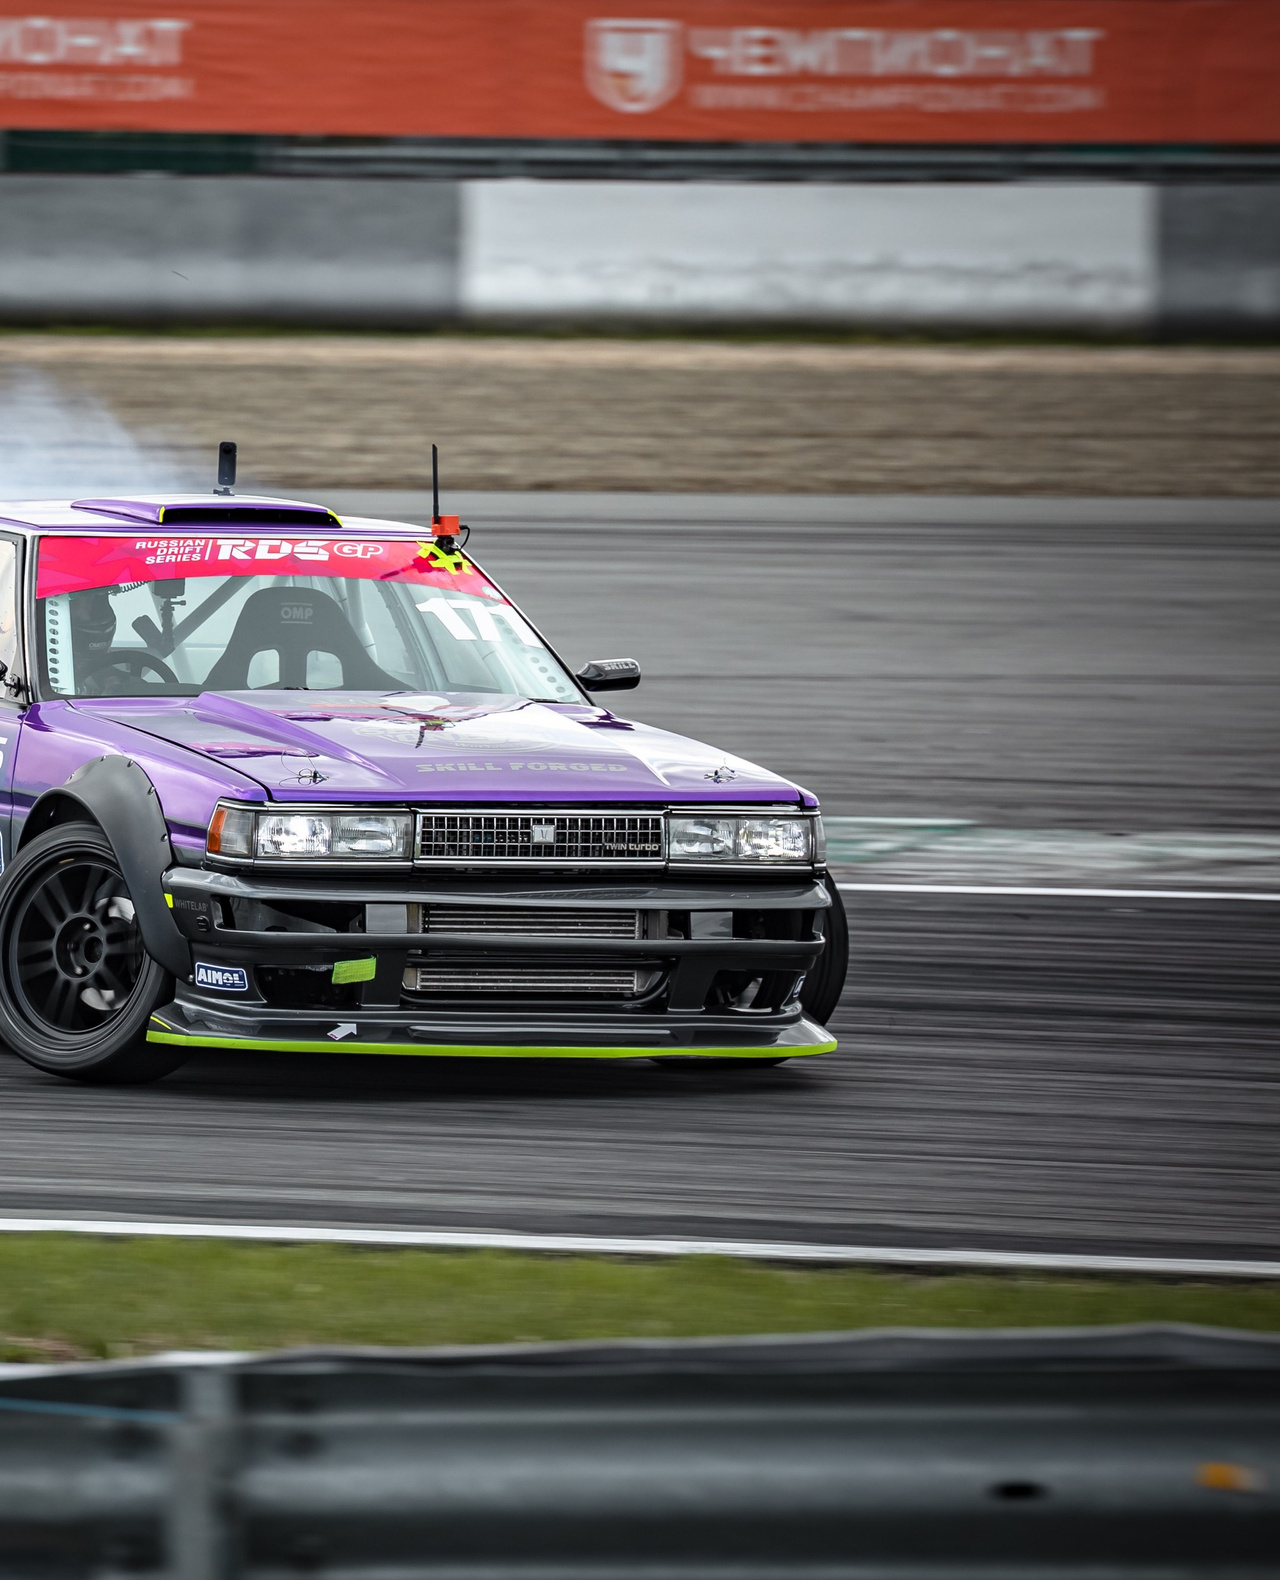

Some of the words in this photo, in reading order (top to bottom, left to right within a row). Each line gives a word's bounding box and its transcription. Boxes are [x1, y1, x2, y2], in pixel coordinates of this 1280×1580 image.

[135, 539, 205, 550] RUSSIAN
[217, 539, 332, 561] RDS
[333, 542, 384, 559] GP
[156, 546, 204, 556] DRIFT
[145, 553, 202, 565] SERIES
[280, 605, 314, 621] OMP
[601, 661, 636, 671] SKILL
[415, 762, 502, 773] SKILL
[508, 762, 628, 773] FORGED
[174, 898, 207, 912] WHITELAB
[198, 968, 245, 986] AIMOL
